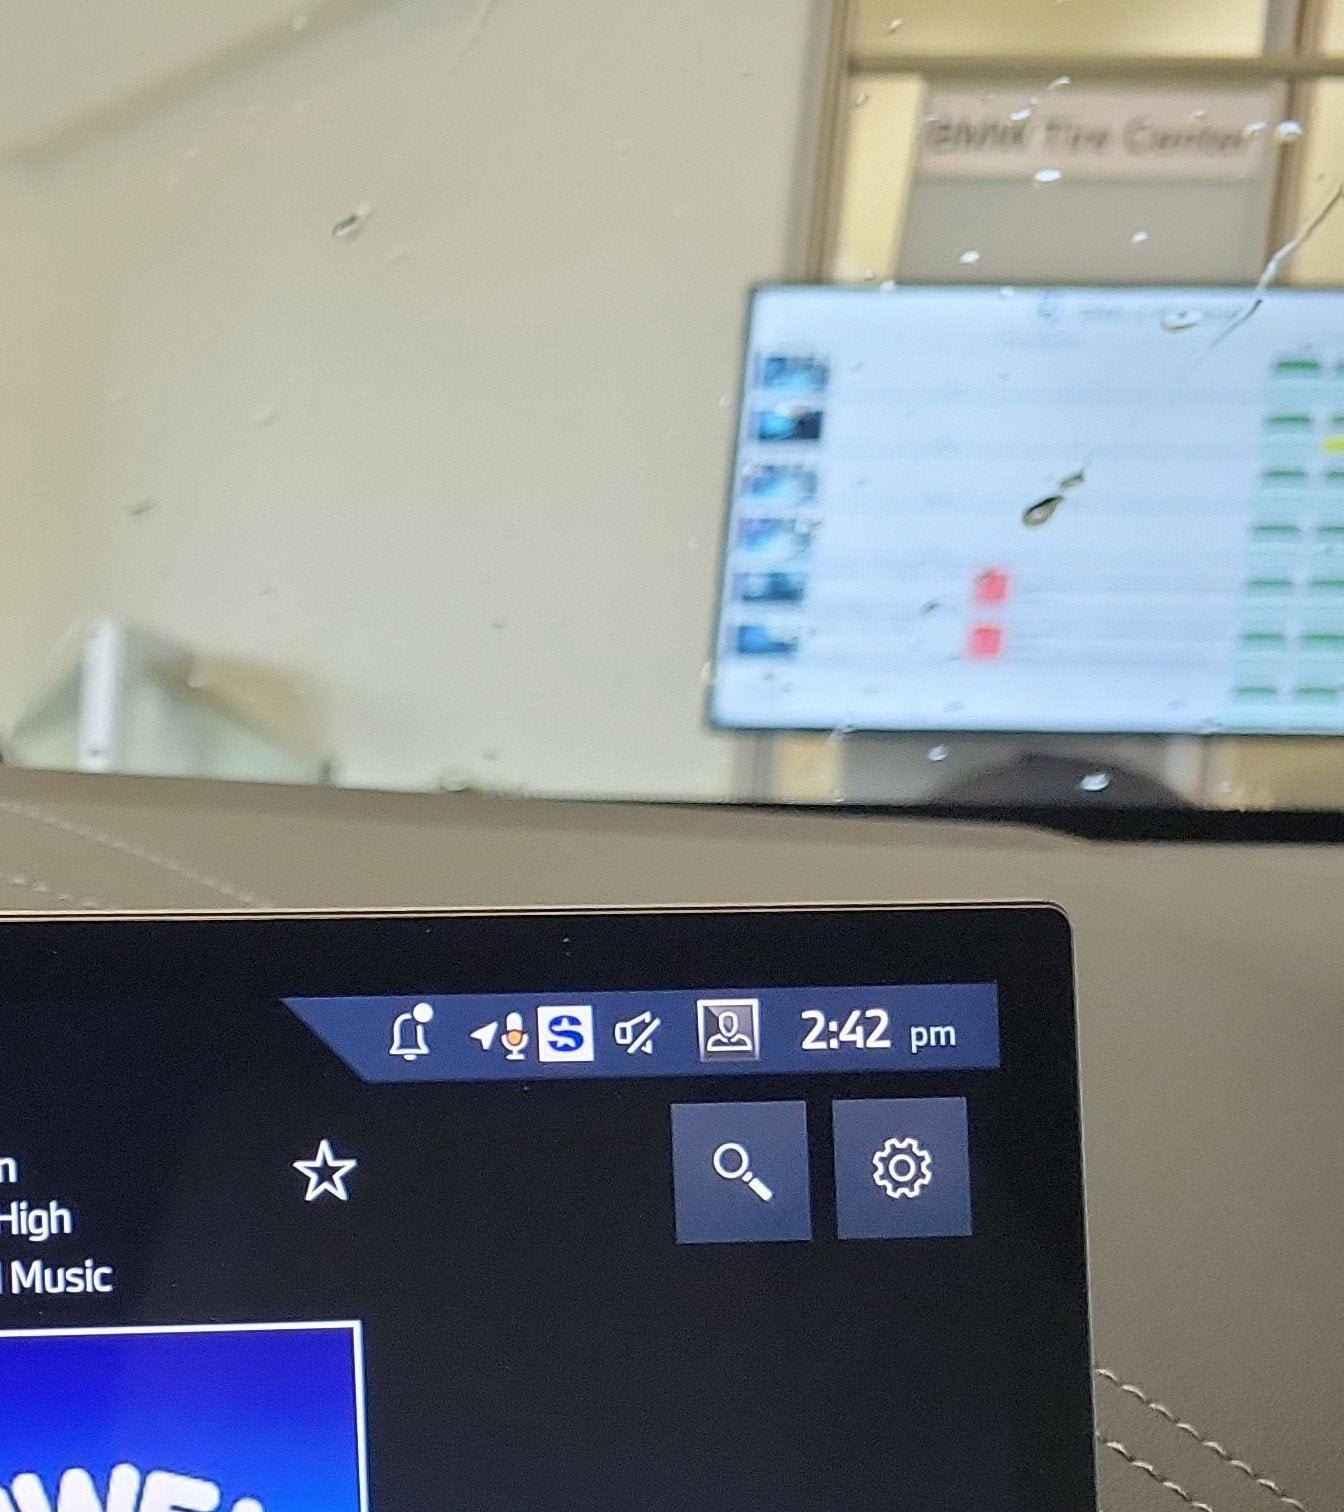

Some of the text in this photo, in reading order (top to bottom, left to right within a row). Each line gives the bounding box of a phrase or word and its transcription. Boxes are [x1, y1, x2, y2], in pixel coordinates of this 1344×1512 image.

[801, 1007, 956, 1054] 2:42 pm
[10, 1258, 113, 1295] Music
